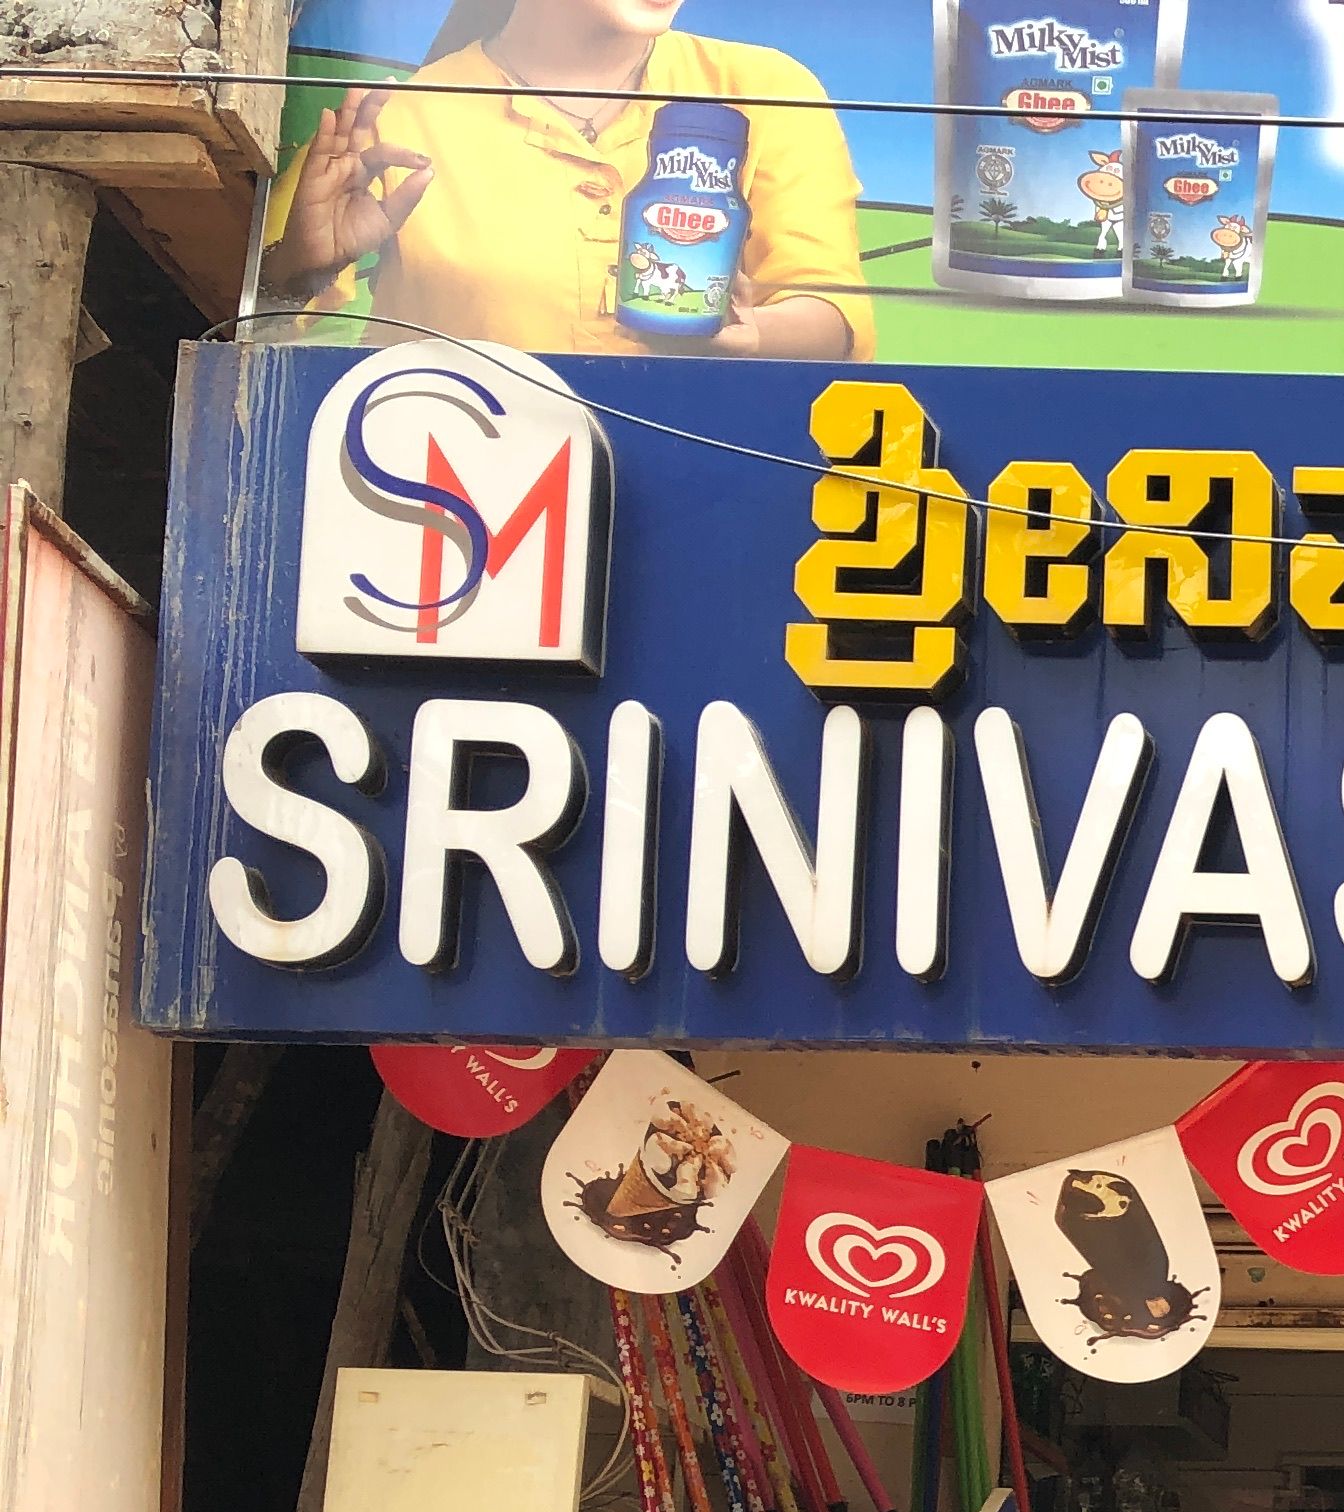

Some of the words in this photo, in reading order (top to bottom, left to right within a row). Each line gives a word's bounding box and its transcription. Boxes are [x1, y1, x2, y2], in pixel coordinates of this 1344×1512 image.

[992, 22, 1085, 54] Milky
[1059, 42, 1121, 69] Mist
[1018, 92, 1076, 111] Ghee
[1159, 134, 1214, 157] Milky
[1200, 144, 1237, 165] Mist
[656, 151, 713, 177] Milky
[696, 170, 732, 190] Mist
[1174, 180, 1209, 194] Ghee
[657, 207, 716, 231] Ghee
[463, 1053, 520, 1115] WALL'S
[784, 1287, 876, 1321] KWALITY
[881, 1308, 947, 1335] WALL'S
[879, 1395, 894, 1407] TO
